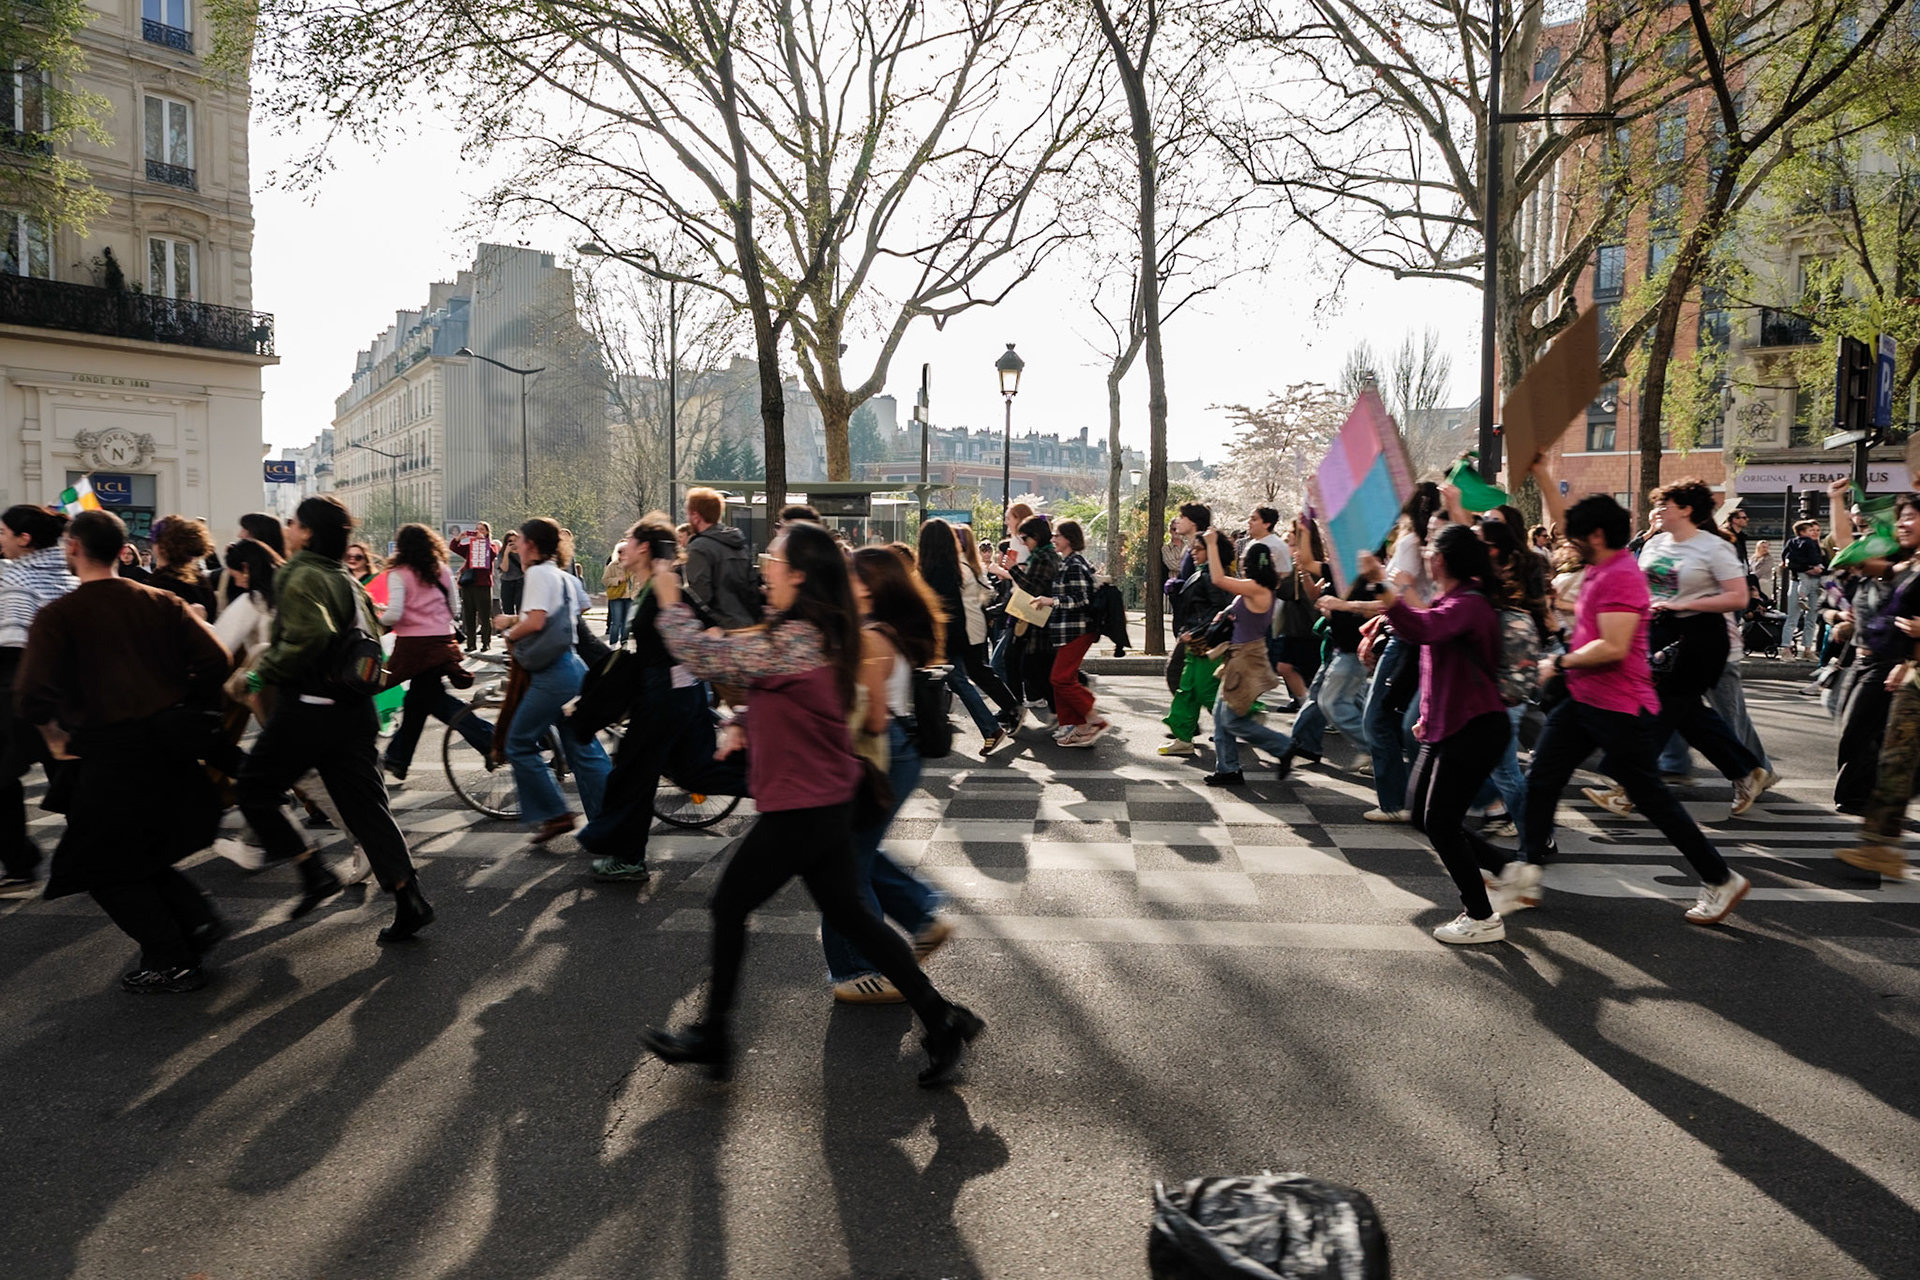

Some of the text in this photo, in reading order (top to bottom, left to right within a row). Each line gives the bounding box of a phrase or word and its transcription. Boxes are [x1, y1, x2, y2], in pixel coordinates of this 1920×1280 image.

[112, 377, 125, 385] EN
[1880, 362, 1891, 407] P
[103, 433, 135, 452] AGENCE
[112, 448, 124, 460] N
[266, 465, 293, 473] LCL
[97, 482, 127, 492] LCL
